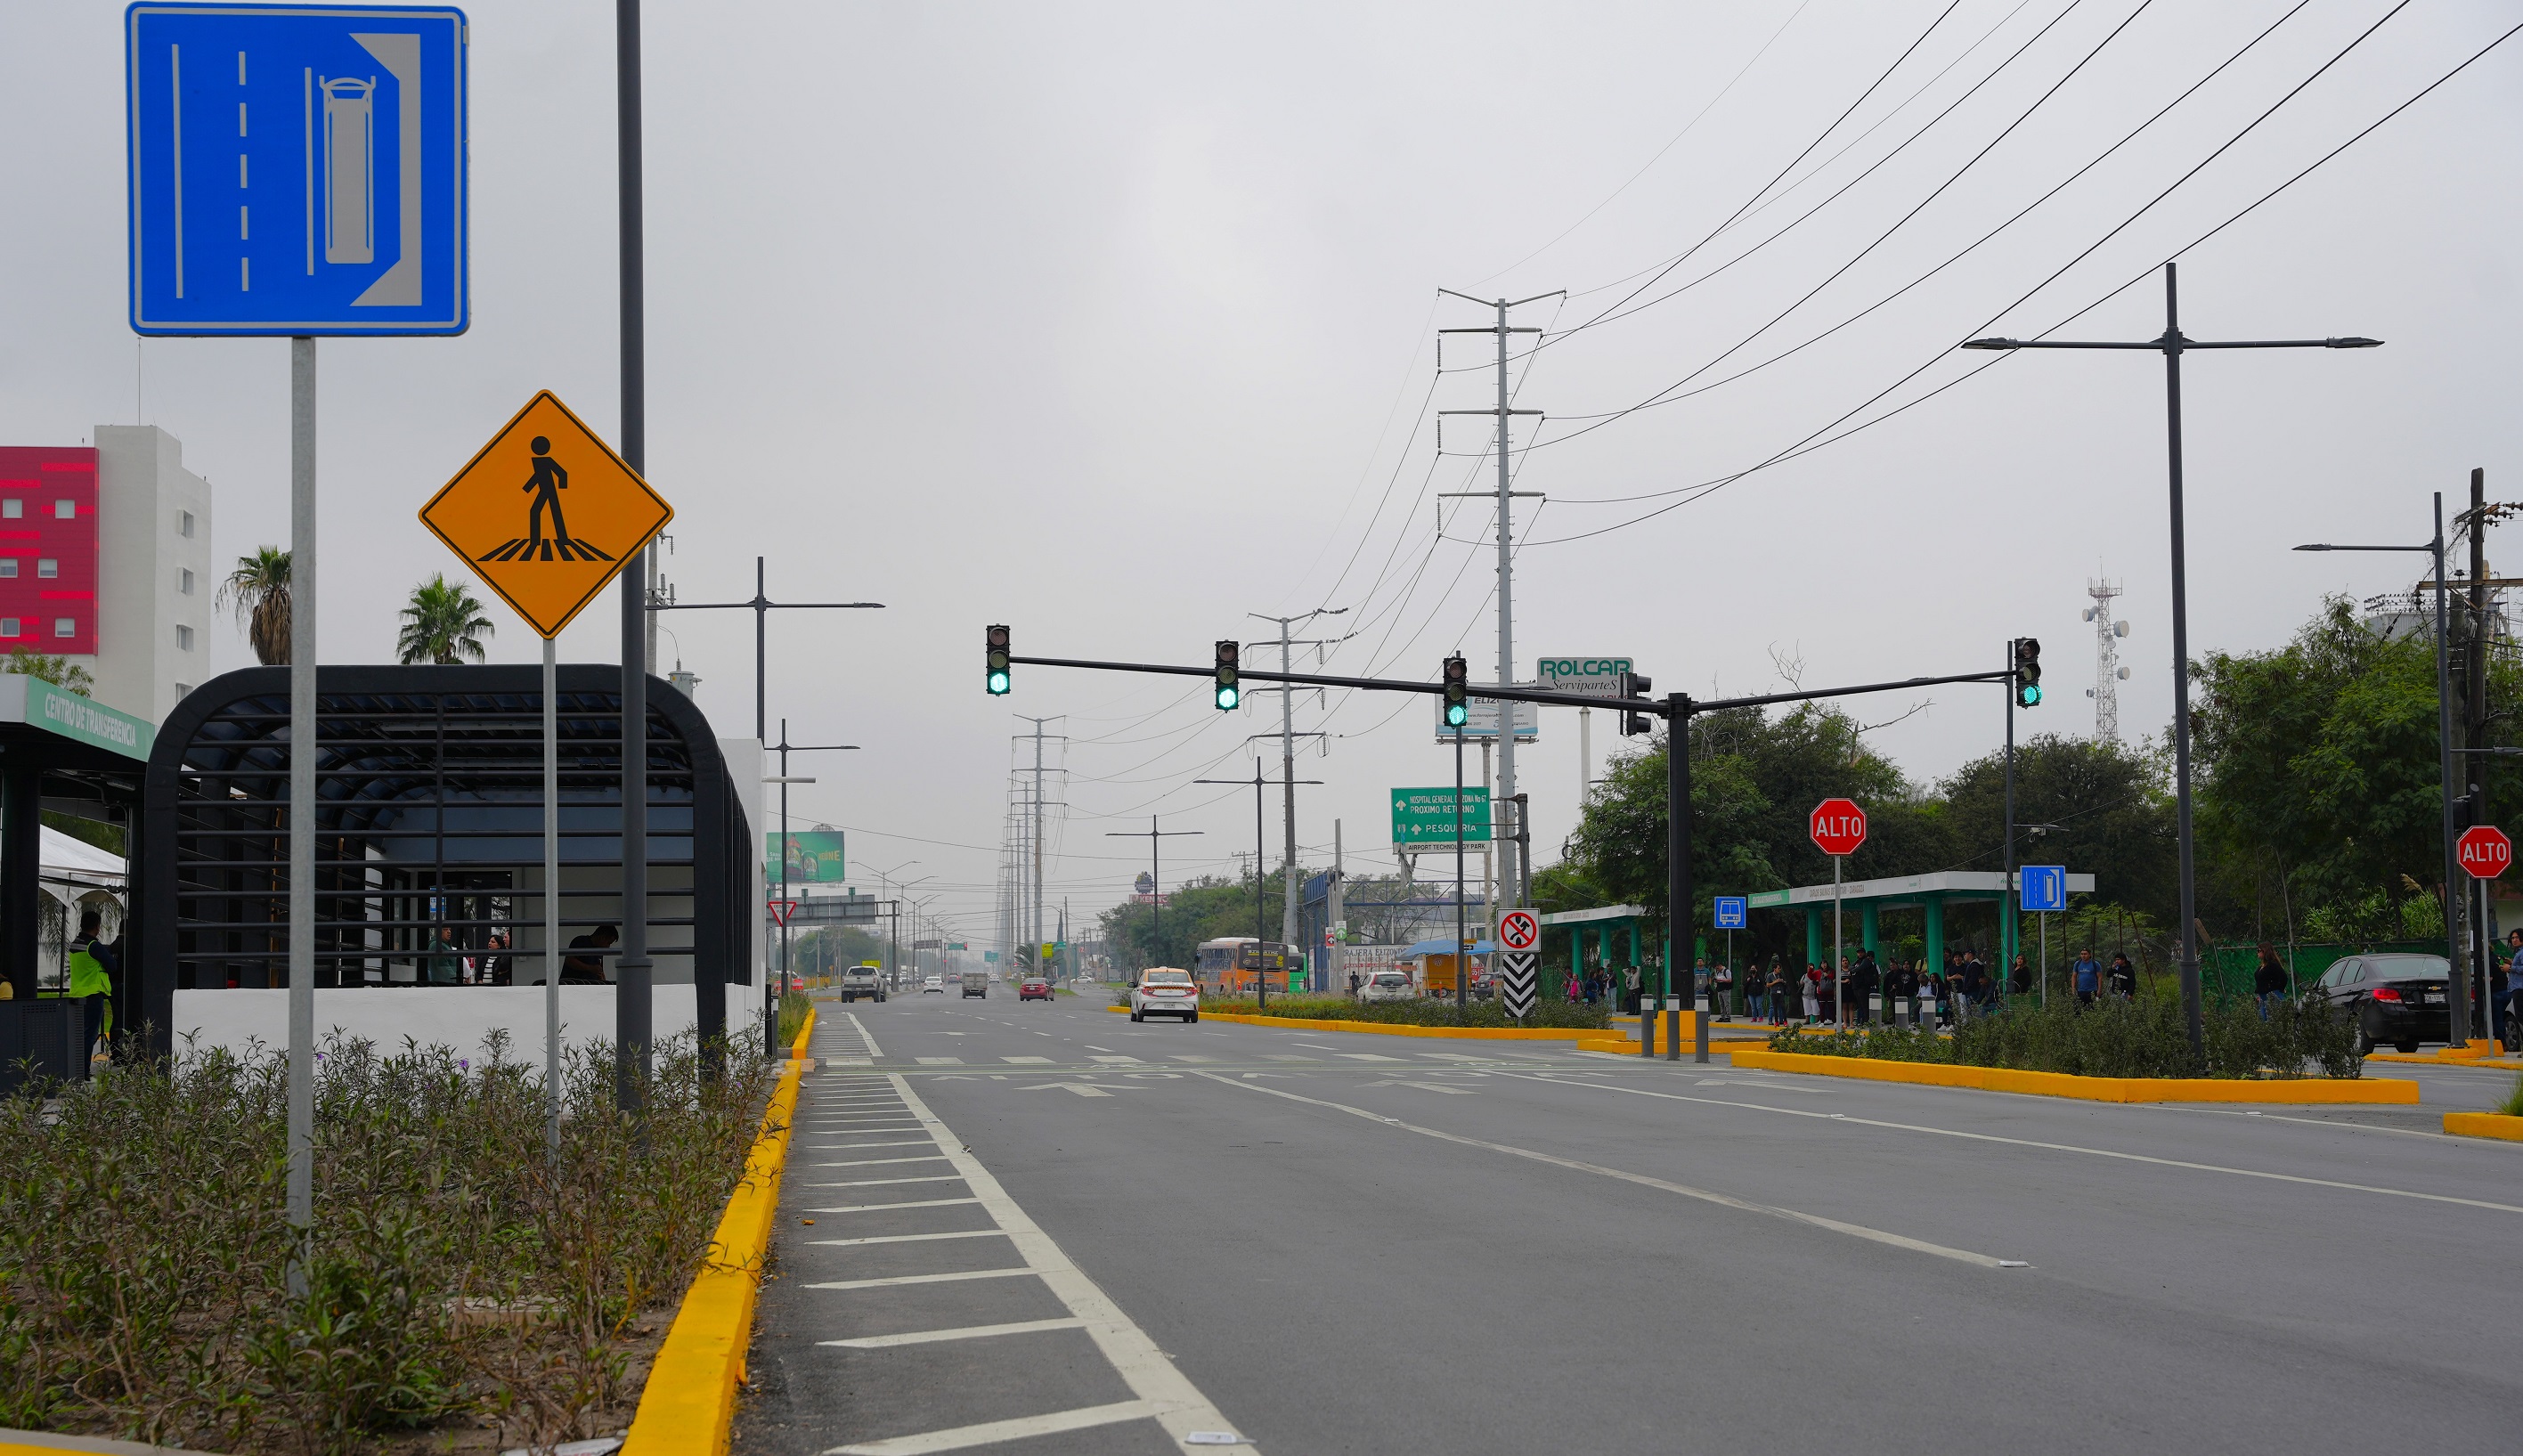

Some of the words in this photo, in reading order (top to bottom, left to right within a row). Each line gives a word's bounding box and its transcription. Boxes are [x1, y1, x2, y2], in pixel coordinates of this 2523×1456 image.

[1540, 660, 1631, 679] ROLCAR
[1553, 679, 1617, 692] ServiparteS
[45, 693, 75, 726] CENTRO
[76, 703, 85, 730] DE
[85, 708, 136, 747] TRANSFERENCIA
[1409, 795, 1431, 804] HOSPITAL
[1432, 795, 1454, 804] GENERAL
[1411, 805, 1441, 814] PROXIMO
[1426, 824, 1477, 833] PESQURIA
[1816, 817, 1862, 837] ALTO
[2462, 842, 2507, 862] ALTO
